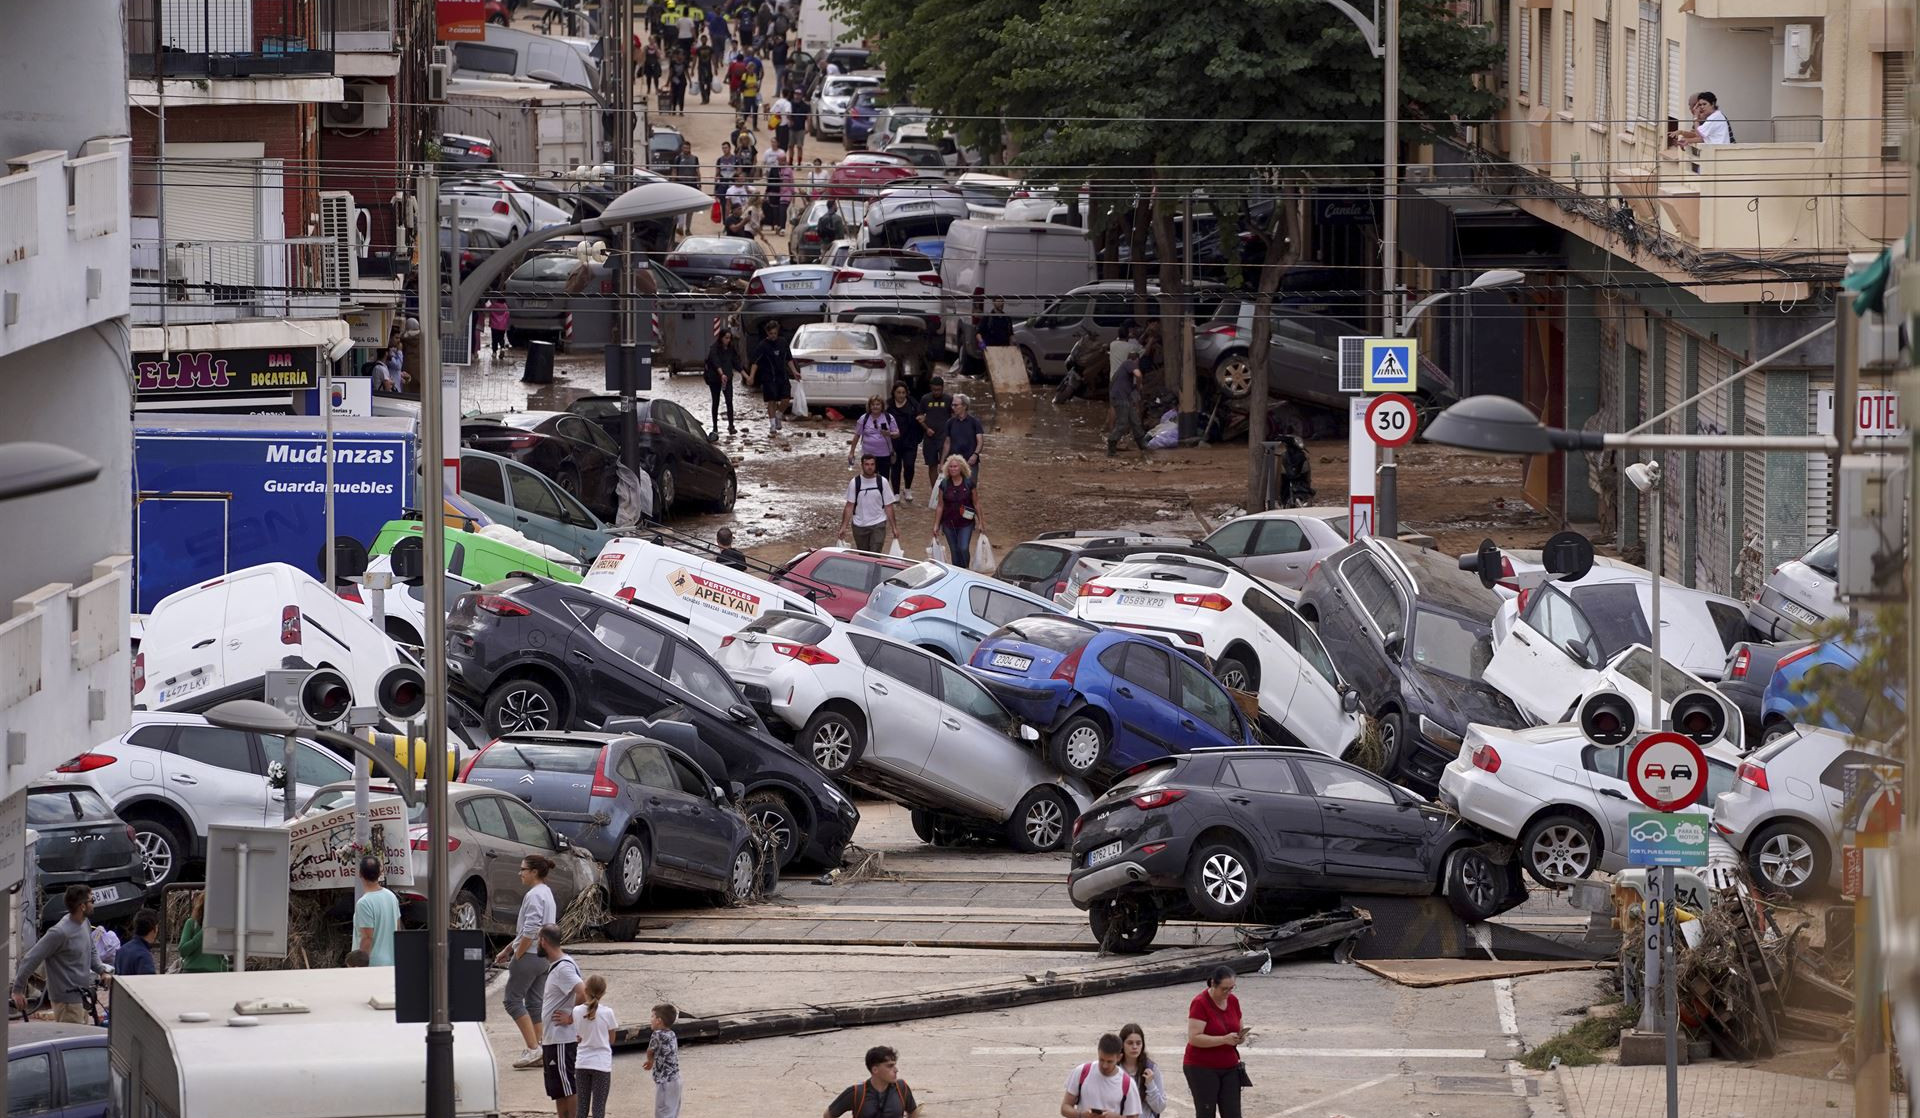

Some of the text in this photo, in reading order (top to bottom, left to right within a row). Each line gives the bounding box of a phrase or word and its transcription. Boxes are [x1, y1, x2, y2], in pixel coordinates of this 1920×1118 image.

[268, 353, 293, 367] BAR
[251, 368, 308, 387] BOCATERÍA
[1378, 410, 1405, 430] 30
[266, 444, 394, 464] Mudanzas
[263, 479, 394, 494] Guardamuebles
[703, 579, 752, 600] VERTICALES
[694, 586, 755, 614] APELYAN
[1146, 596, 1164, 607] KPD
[1014, 658, 1027, 669] CTL
[190, 677, 208, 690] LKV
[311, 824, 319, 832] A
[322, 815, 345, 828] LOS
[347, 805, 401, 819] TNES!!
[317, 869, 336, 881] por
[340, 866, 356, 878] las
